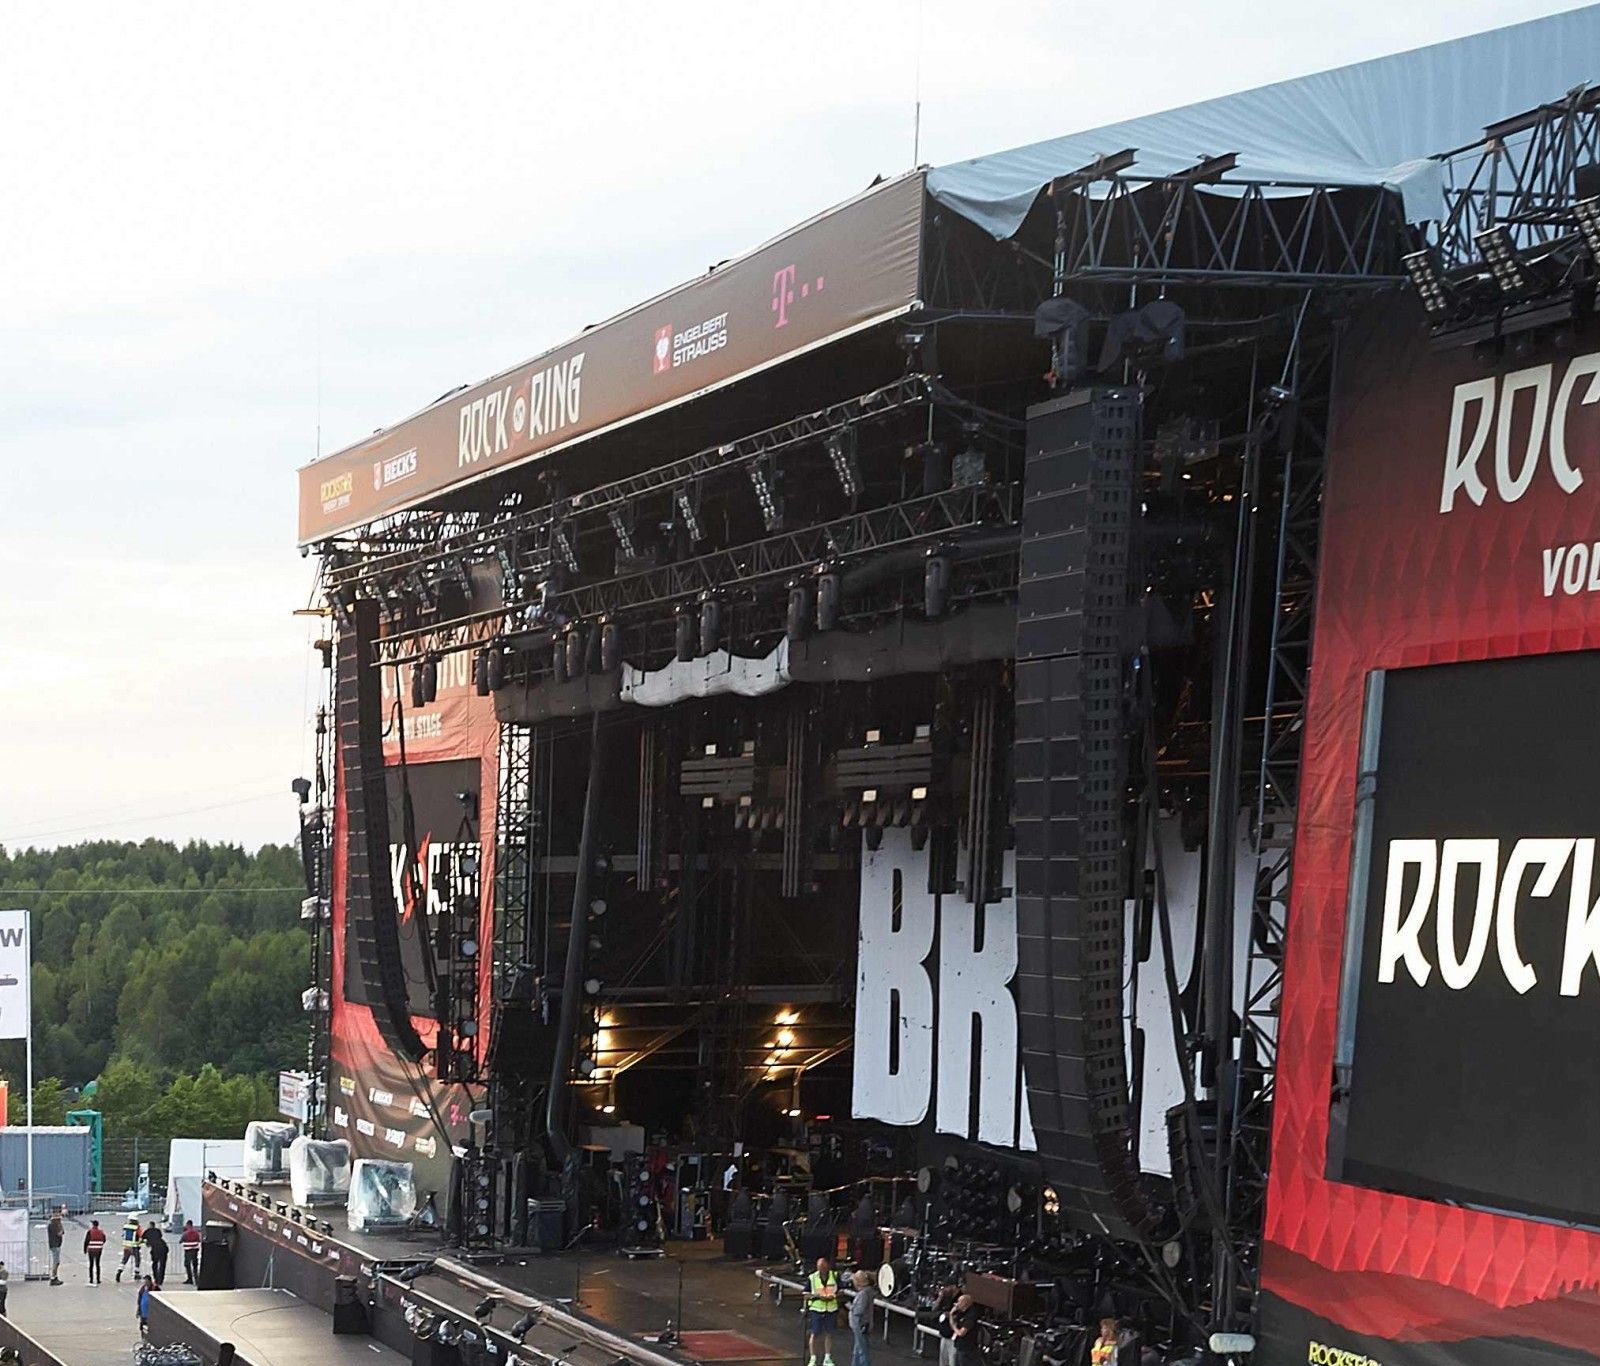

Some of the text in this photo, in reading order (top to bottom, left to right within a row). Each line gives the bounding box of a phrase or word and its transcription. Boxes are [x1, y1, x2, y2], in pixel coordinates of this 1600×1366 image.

[672, 329, 728, 367] STRAUSS
[673, 312, 729, 348] ENGELBERT
[458, 385, 513, 468] ROCK
[529, 352, 585, 440] RING
